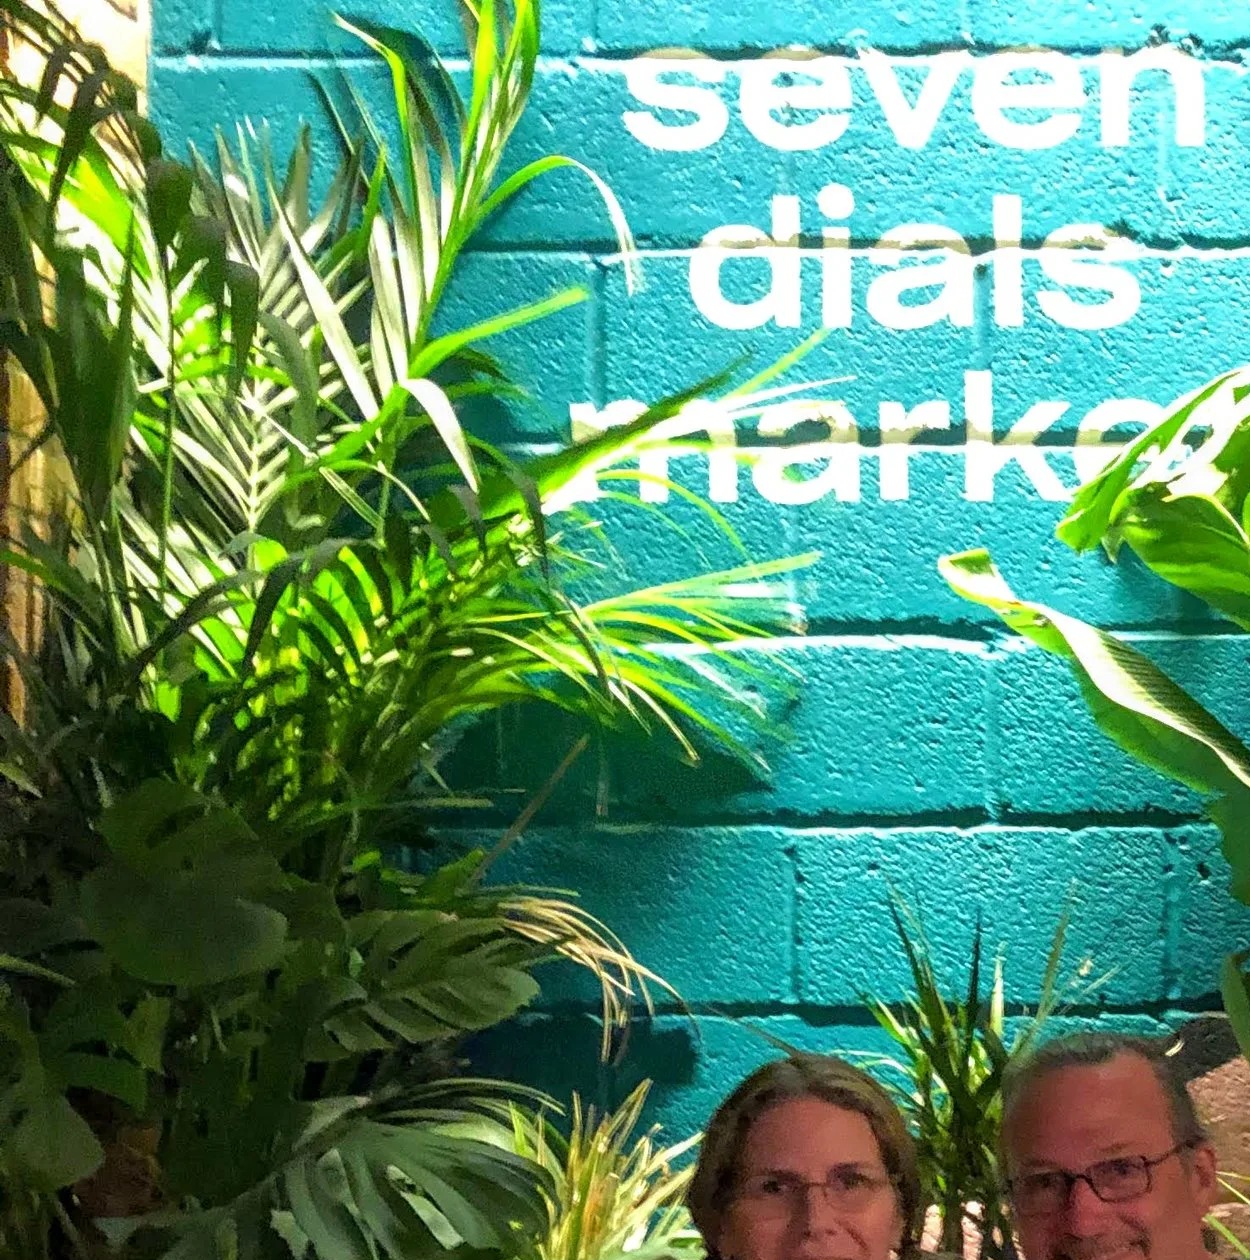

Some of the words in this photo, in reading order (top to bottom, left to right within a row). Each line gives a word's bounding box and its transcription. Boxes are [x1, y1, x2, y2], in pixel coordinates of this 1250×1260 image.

[622, 47, 1205, 152] seven
[688, 184, 1143, 330] dials
[569, 370, 1172, 506] mark
